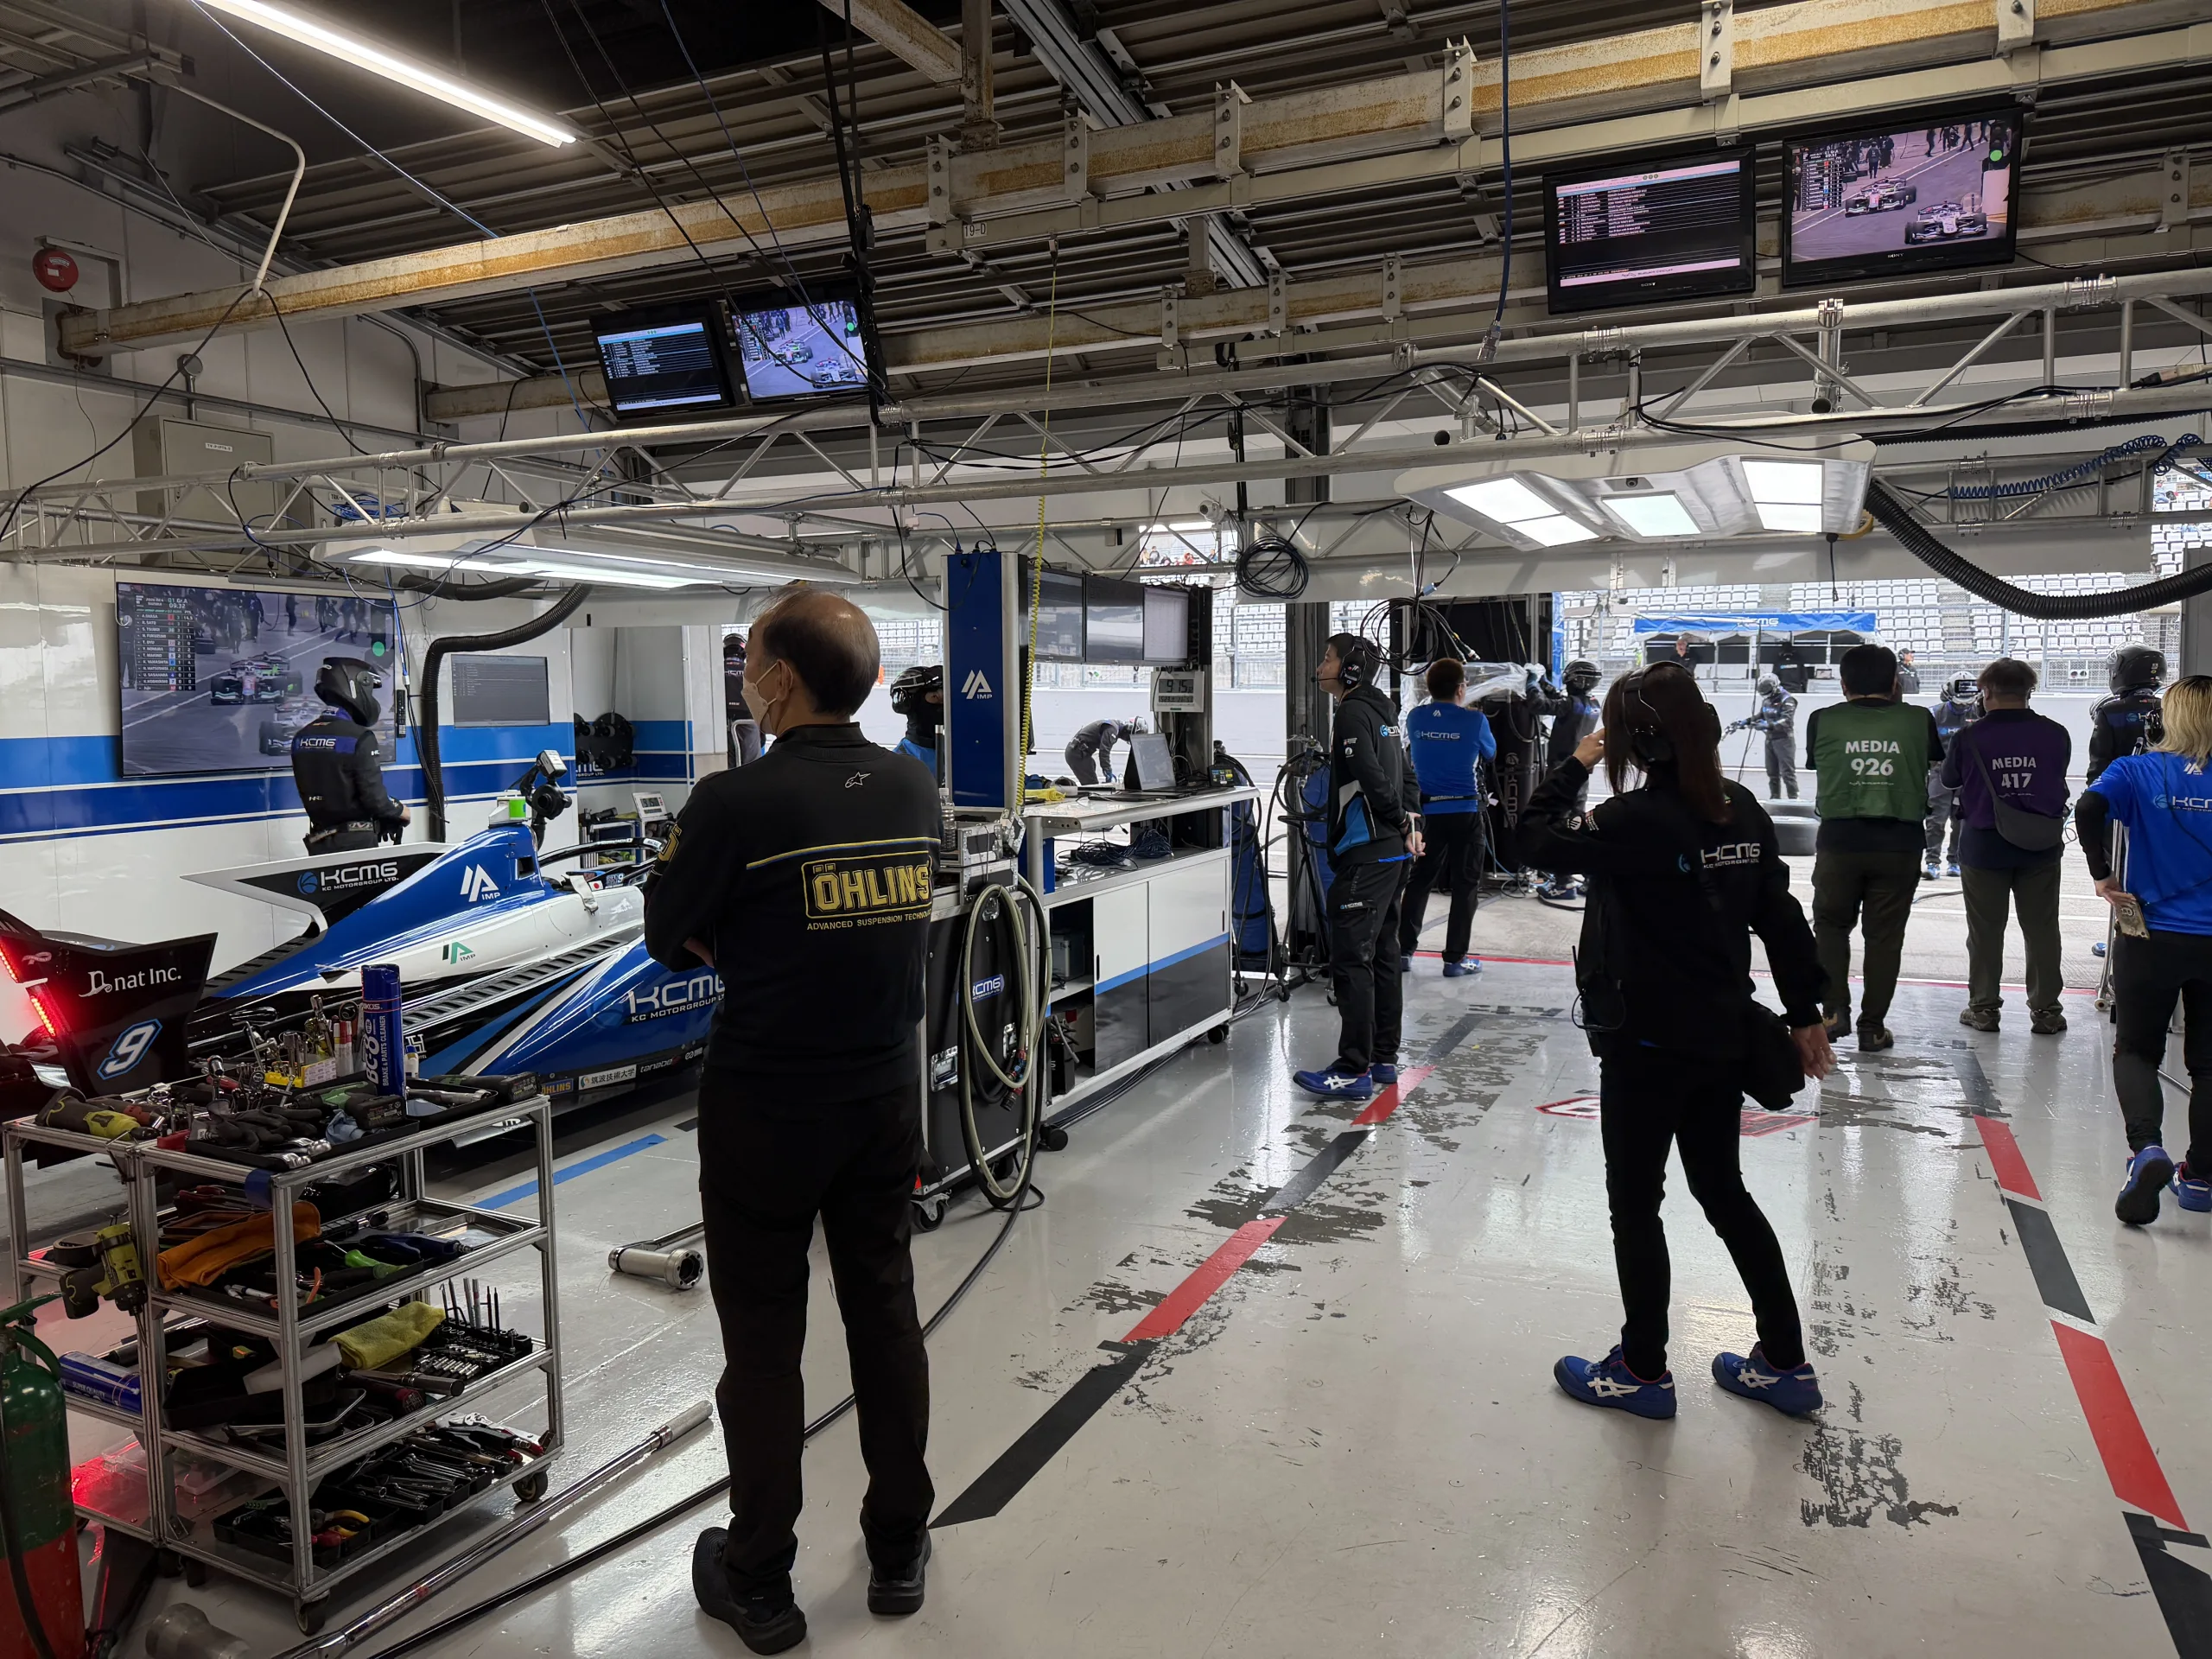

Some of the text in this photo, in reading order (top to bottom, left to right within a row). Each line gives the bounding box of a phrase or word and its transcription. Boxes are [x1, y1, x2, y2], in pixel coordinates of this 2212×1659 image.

[301, 738, 336, 747] KCMG
[1421, 730, 1460, 740] KCMG
[1845, 740, 1901, 754] MEDIA
[1850, 758, 1894, 776] 926
[1992, 756, 2037, 771] MEDIA
[2001, 772, 2032, 789] 417
[2172, 795, 2212, 809] KC
[321, 861, 398, 887] KCMG
[334, 878, 383, 890] MOTORGROUP
[812, 862, 929, 912] ÖHLINS
[481, 892, 501, 900] IMP
[806, 920, 853, 931] ADVANCED
[856, 915, 903, 926] SUSPENSION
[460, 953, 476, 962] IMP
[149, 967, 181, 984] Inc.
[632, 1014, 646, 1022] KC
[650, 998, 716, 1019] MOTORGROUP
[100, 1020, 161, 1078] 9
[640, 1058, 673, 1073] tanabe
[590, 1068, 635, 1084] 筑波技術大学
[73, 1381, 106, 1398] SUPER QUALITY
